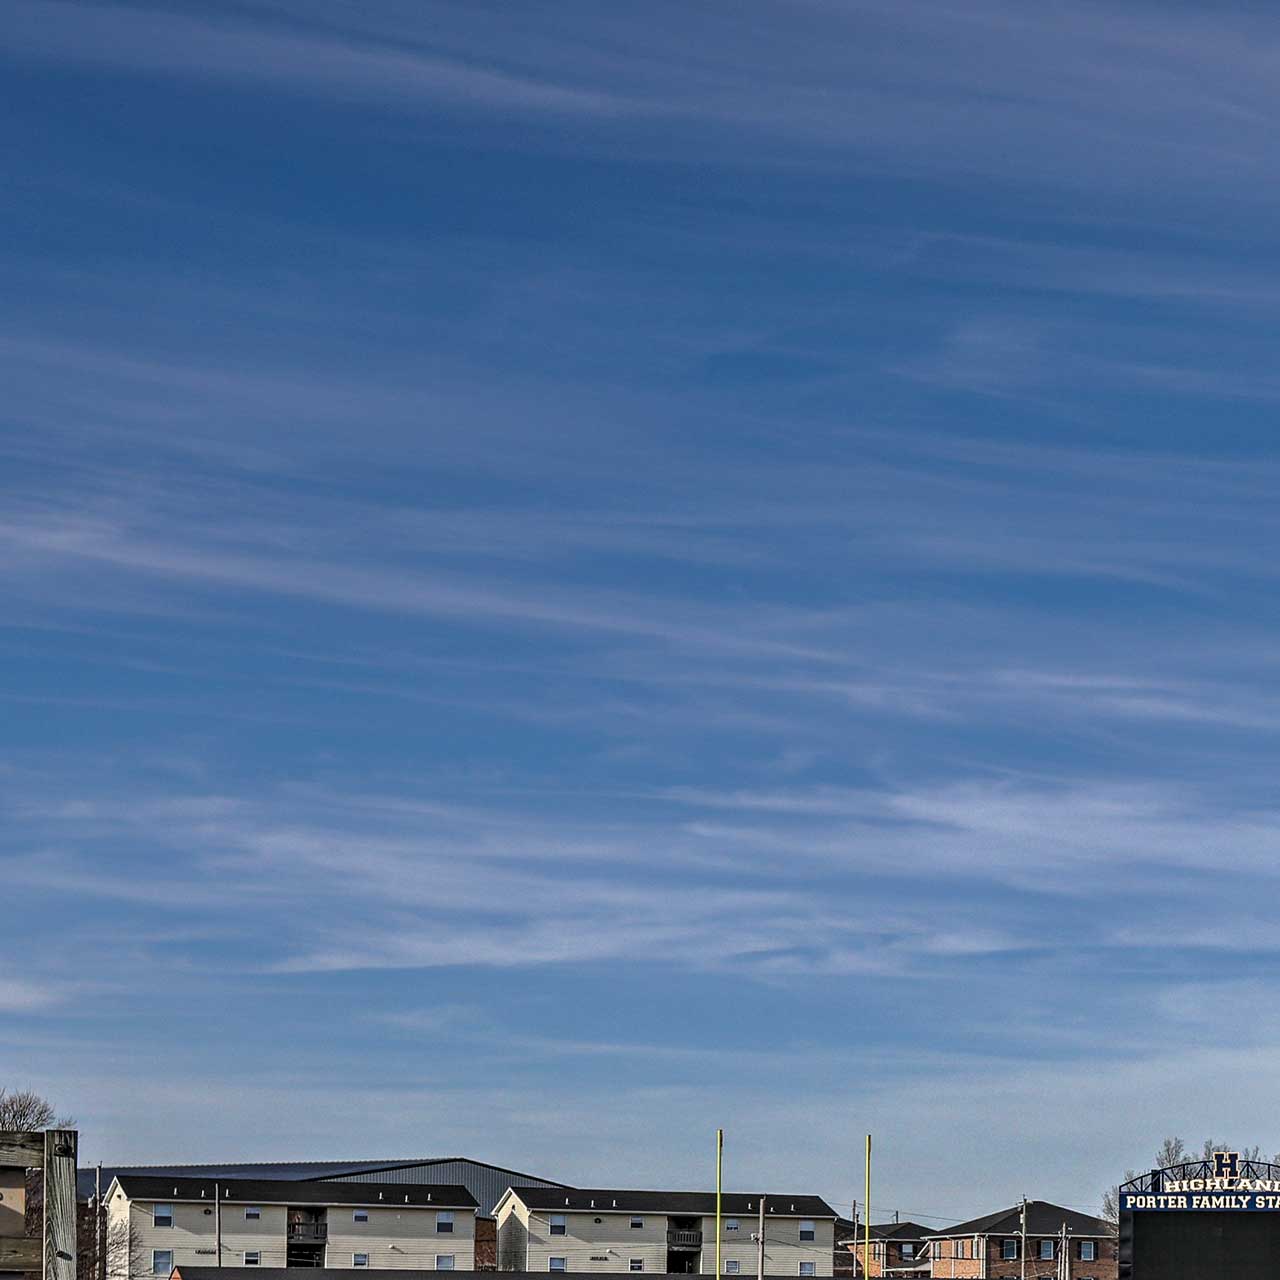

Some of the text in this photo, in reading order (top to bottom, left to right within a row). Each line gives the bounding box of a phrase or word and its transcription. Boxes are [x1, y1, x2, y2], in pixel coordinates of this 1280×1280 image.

[1213, 1152, 1240, 1179] H
[1126, 1196, 1187, 1209] PORTER
[1192, 1196, 1251, 1209] FAMILY
